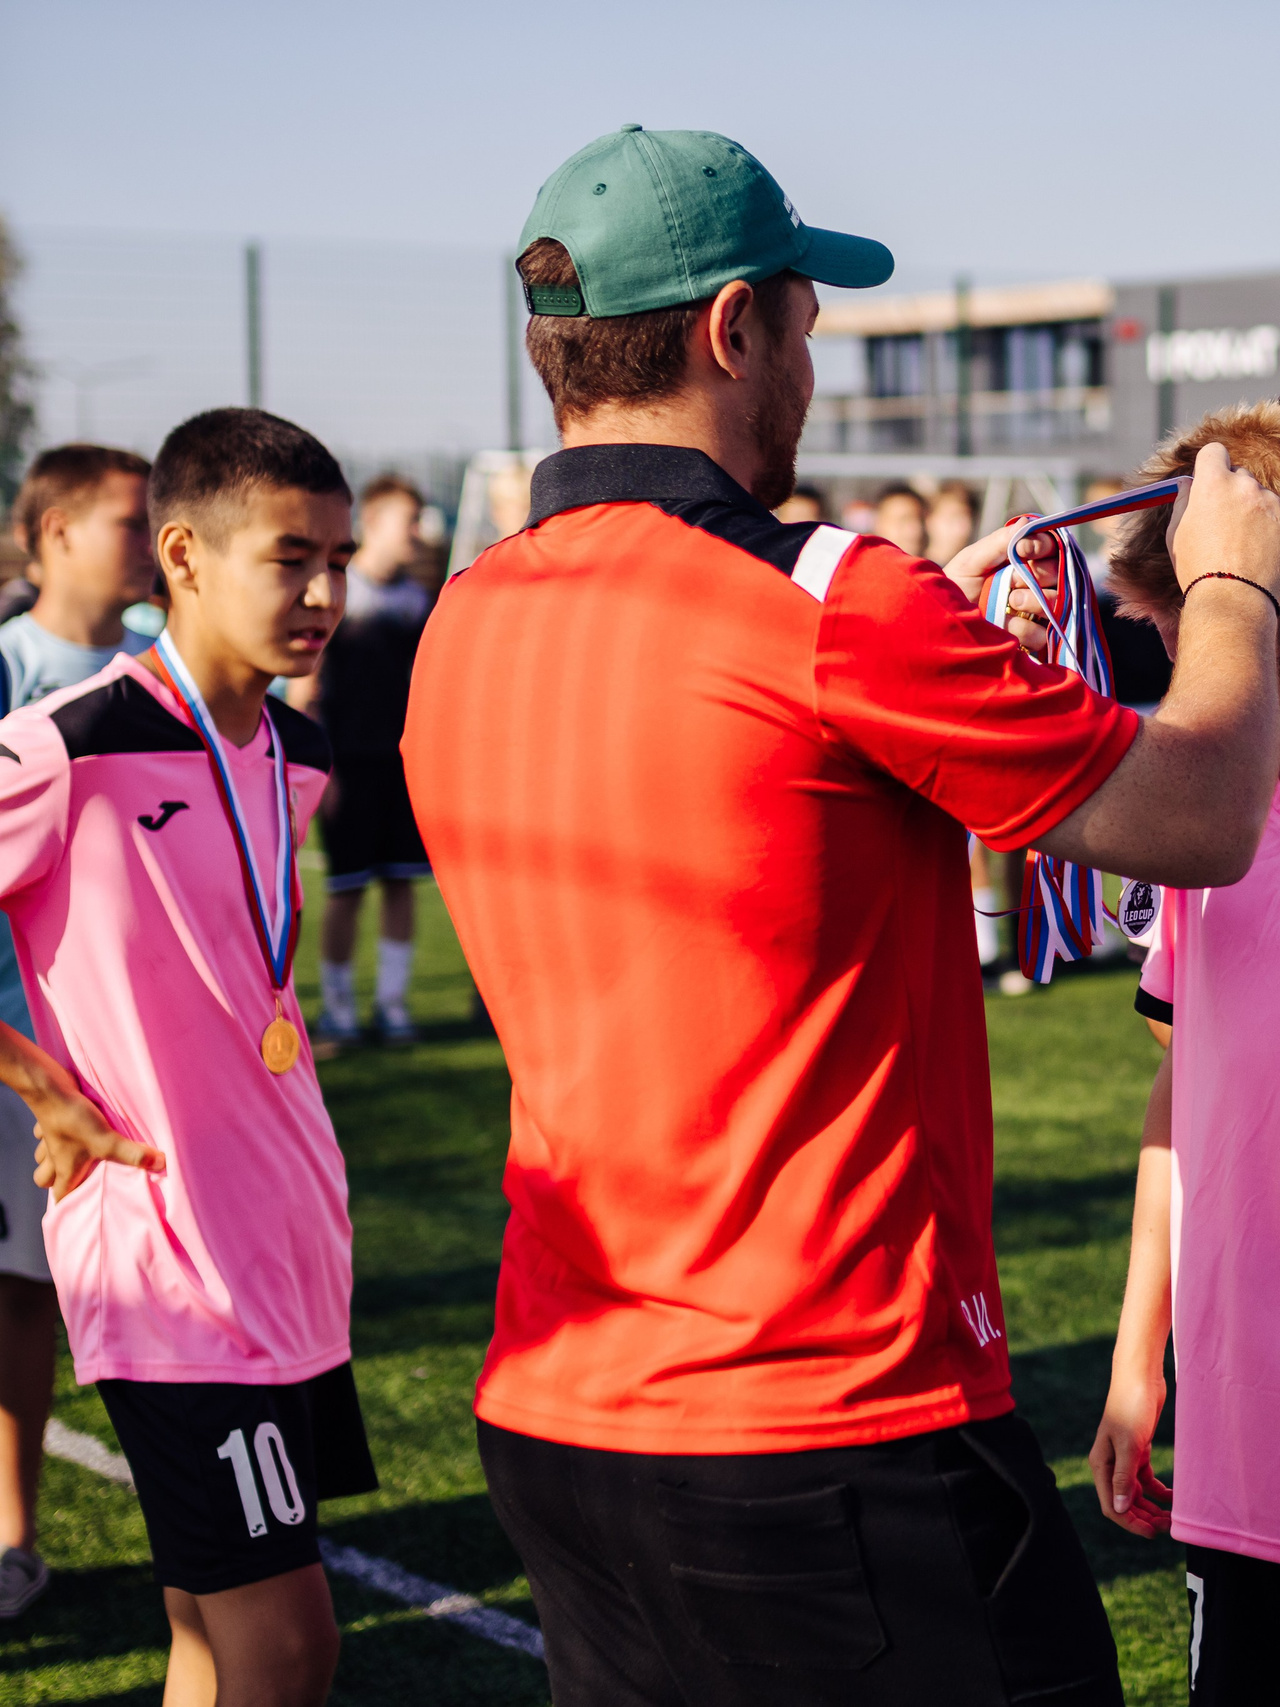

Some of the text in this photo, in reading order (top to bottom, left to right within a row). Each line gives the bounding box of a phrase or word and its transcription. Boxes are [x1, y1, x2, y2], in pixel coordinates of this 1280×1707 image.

[1125, 908, 1153, 922] LEO CUP
[216, 1421, 306, 1539] 10
